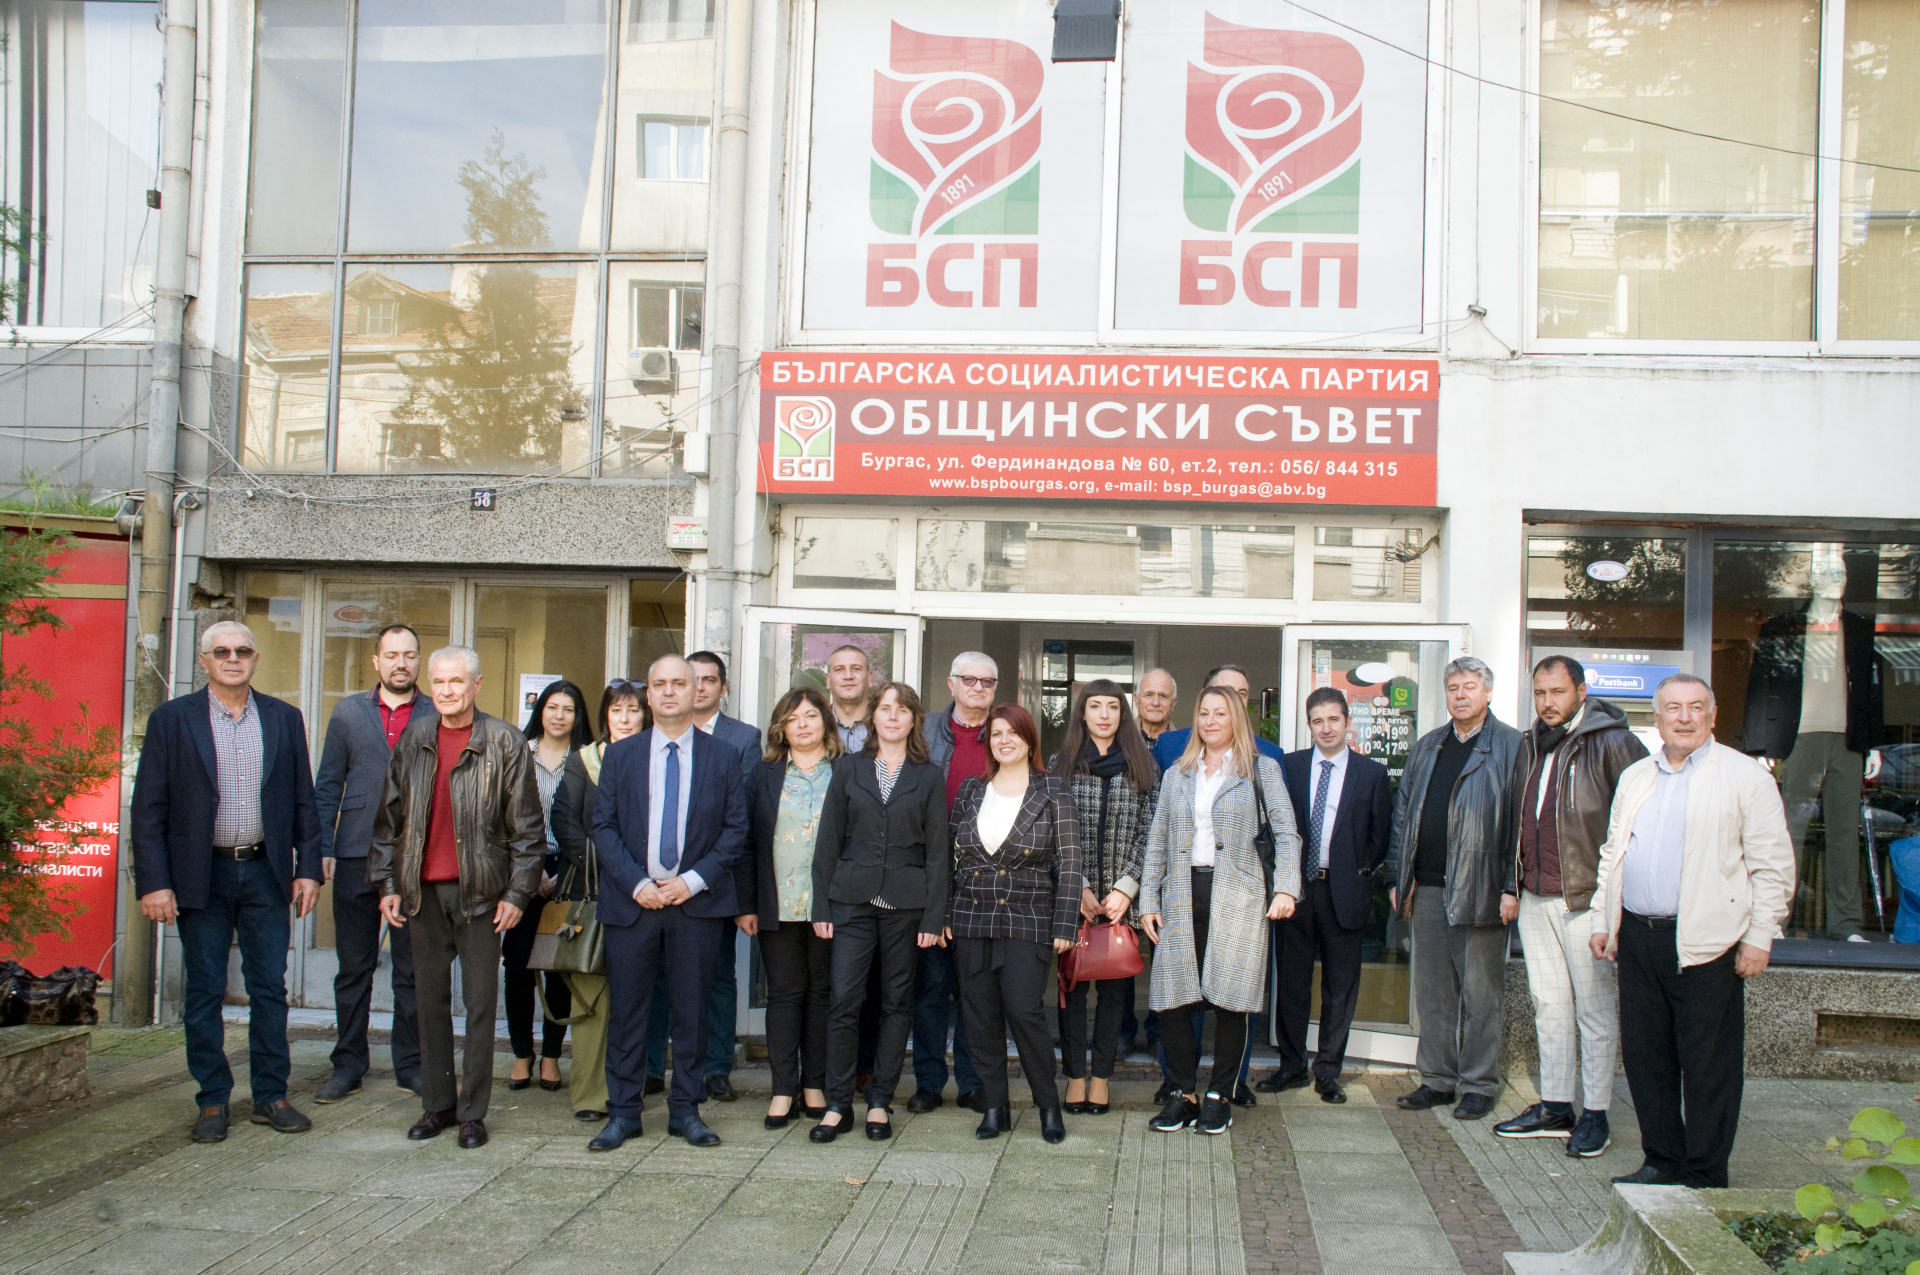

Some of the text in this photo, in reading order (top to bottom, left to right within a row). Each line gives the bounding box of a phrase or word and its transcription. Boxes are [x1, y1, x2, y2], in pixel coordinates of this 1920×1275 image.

[940, 173, 975, 205] 1891
[1257, 170, 1293, 202] 1891
[865, 242, 1039, 308] БСП
[1179, 239, 1360, 309] БСП
[772, 361, 1429, 392] БЪЛГАРСКА СОЦИАЛИСТИЧЕСКА ПАРТИЯ
[850, 398, 1422, 445] ОБЩИНСКИ СЪВЕТ
[778, 458, 831, 478] БСП
[861, 452, 1398, 477] Бургас, ул. Фердинандова № 60, ет.2, тел.: 056/ 844 315
[929, 476, 1326, 498] www.bspbourgas.org, e-mail: bsp_burgas@abv.bg
[474, 491, 491, 507] 58
[673, 524, 702, 534] DigiCom
[1599, 677, 1638, 687] Postbank
[1371, 708, 1400, 716] ВРЕМЕ
[103, 822, 119, 834] на
